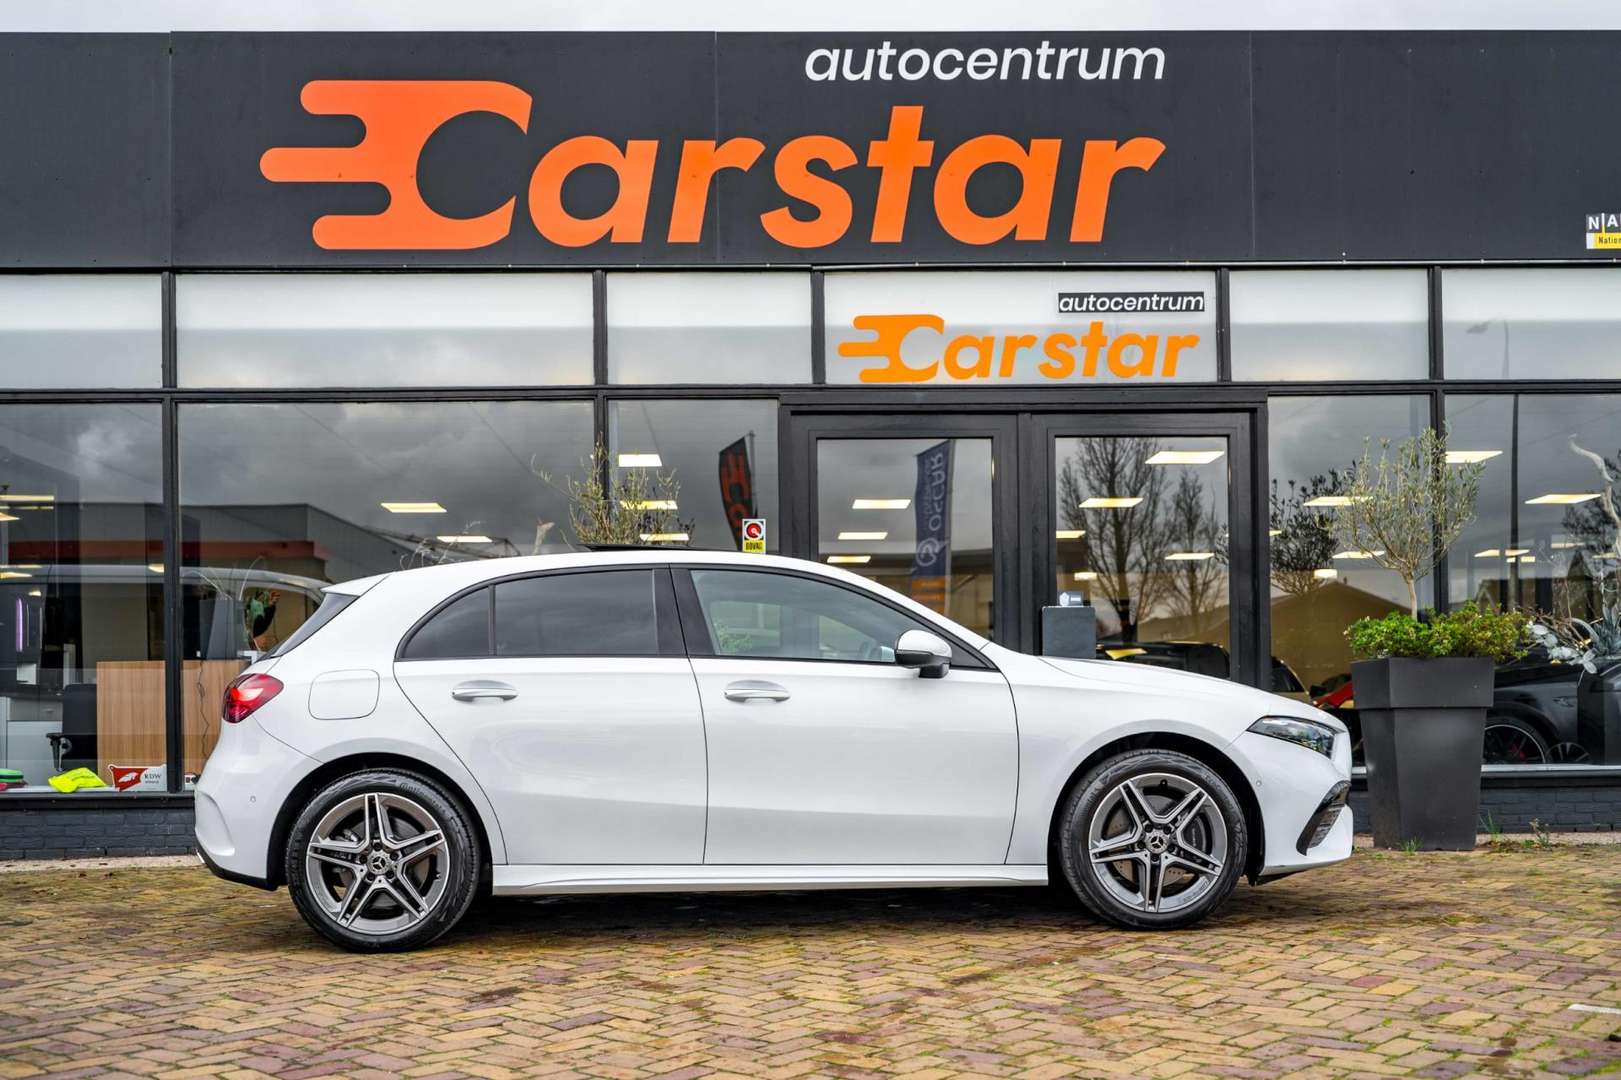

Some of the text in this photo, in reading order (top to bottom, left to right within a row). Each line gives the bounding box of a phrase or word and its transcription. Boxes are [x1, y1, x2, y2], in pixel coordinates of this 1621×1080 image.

[805, 41, 1166, 82] autocentrum
[259, 79, 1166, 250] Carstar
[1059, 293, 1205, 312] autocentrum
[837, 313, 1201, 384] Carstar
